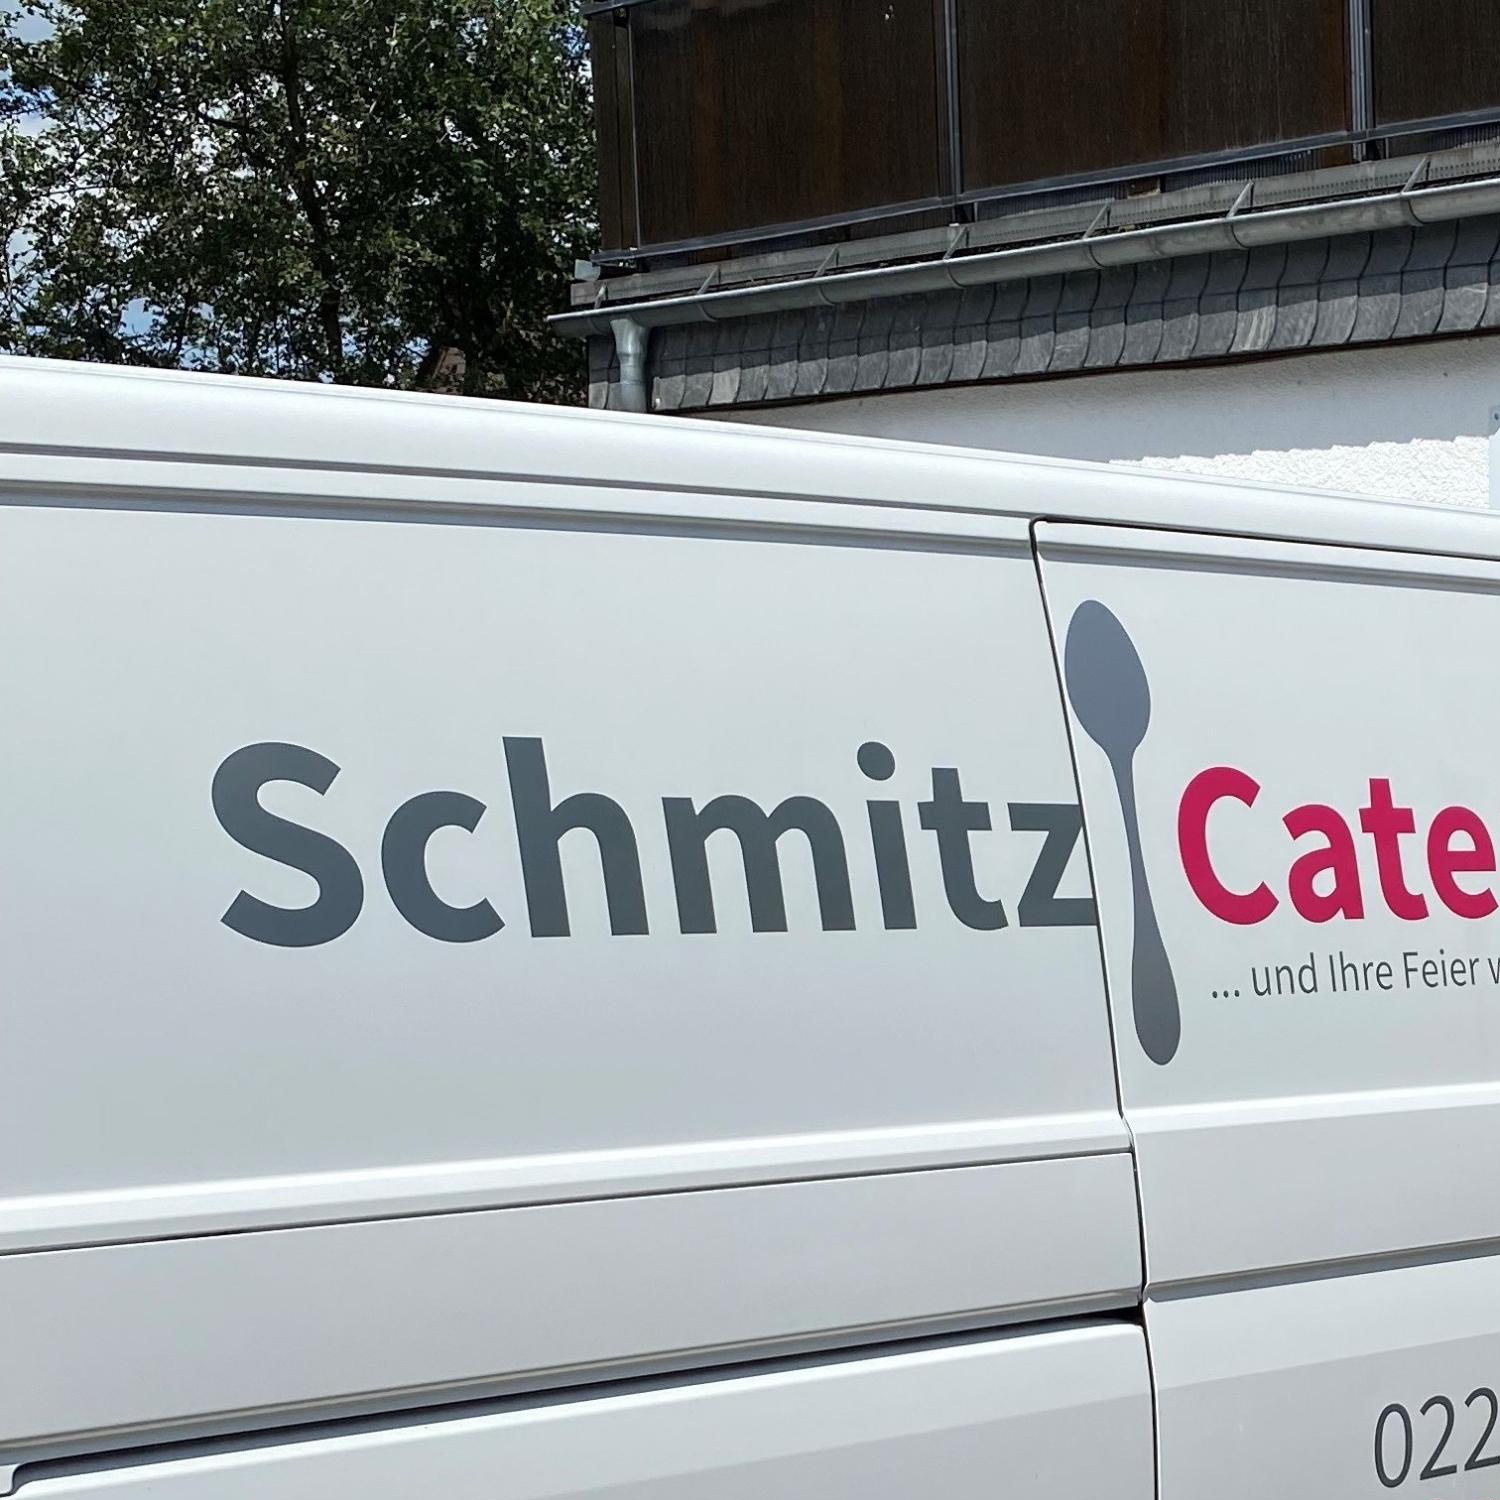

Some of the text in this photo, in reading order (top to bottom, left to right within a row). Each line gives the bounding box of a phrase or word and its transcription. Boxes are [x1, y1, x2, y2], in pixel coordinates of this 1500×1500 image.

[212, 737, 1099, 947] Schmitz
[1252, 952, 1318, 996] und
[1329, 951, 1393, 992] Ihre
[1403, 949, 1479, 988] Feier
